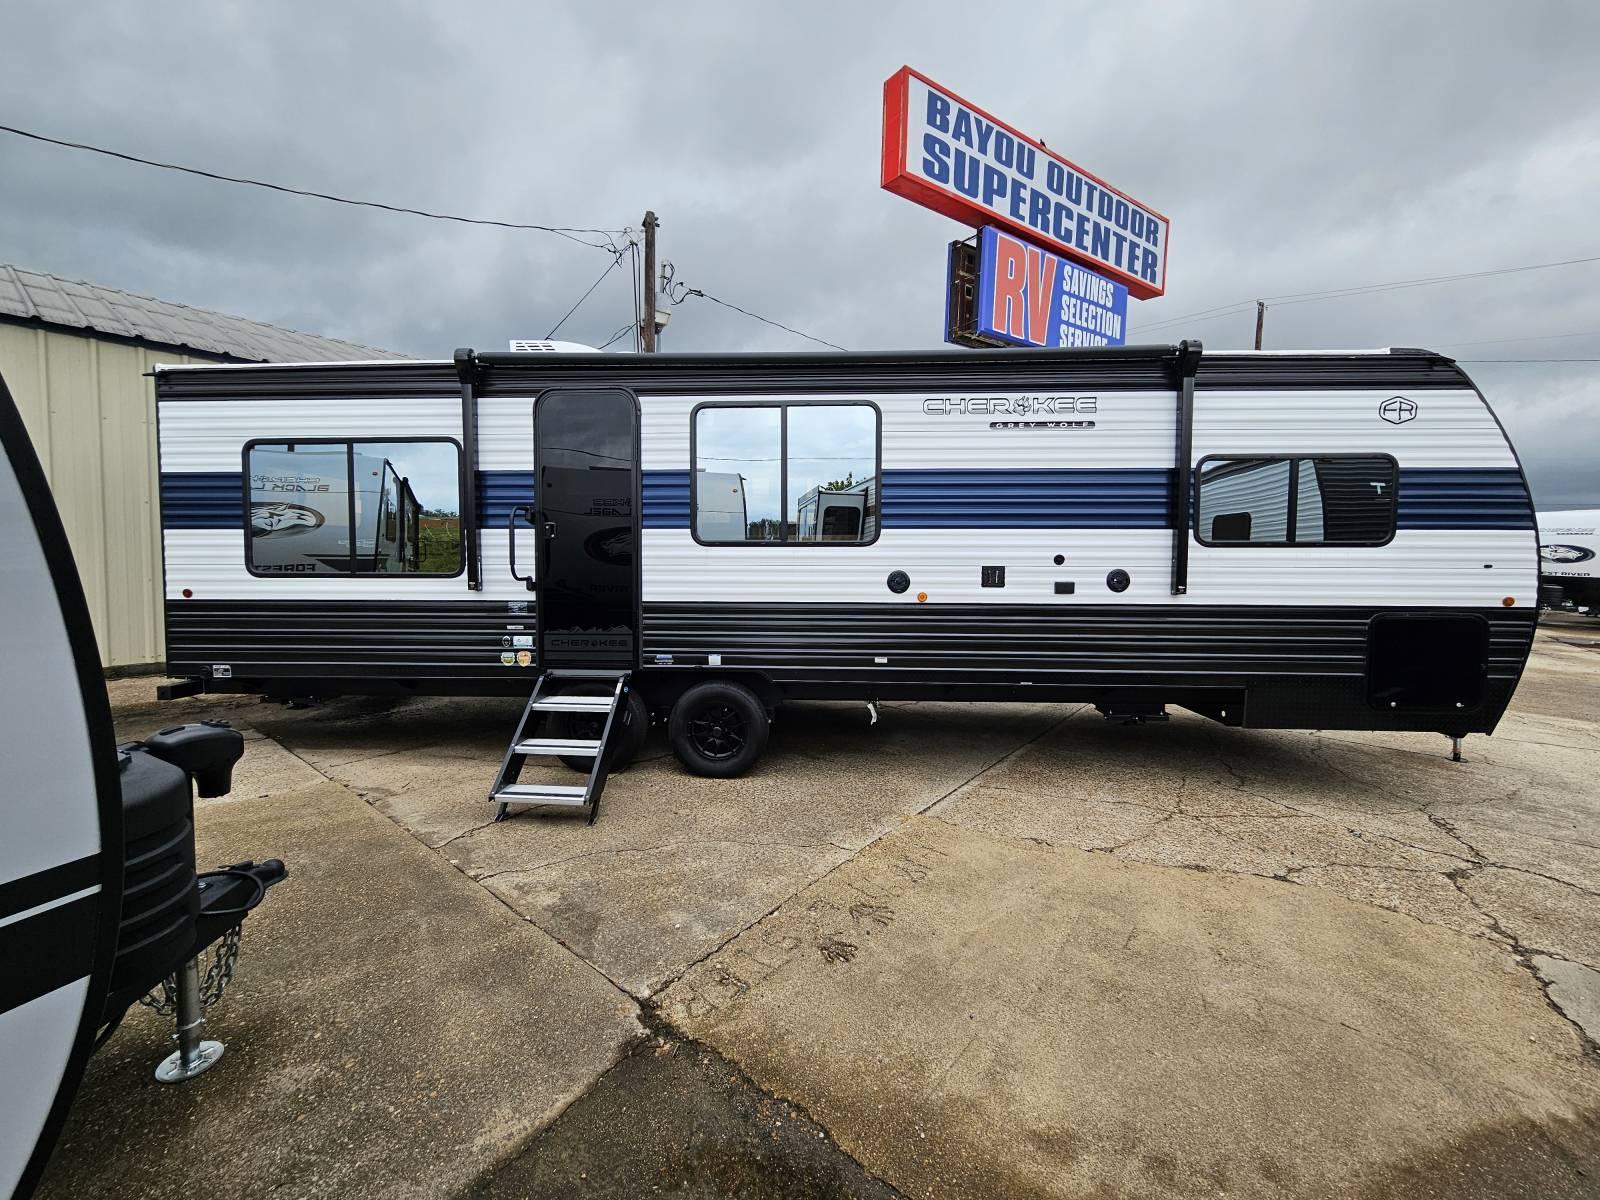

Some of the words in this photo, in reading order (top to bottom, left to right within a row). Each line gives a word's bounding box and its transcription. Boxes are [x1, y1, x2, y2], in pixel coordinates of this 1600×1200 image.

[927, 89, 1035, 180] BAYOU
[1046, 160, 1160, 248] OUTDOOR
[922, 132, 1158, 285] SUPERCENTER
[992, 233, 1057, 346] RV
[1060, 295, 1122, 340] SELECTION
[1062, 265, 1114, 308] SAVINGS
[995, 422, 1036, 430] GREY
[1047, 421, 1089, 429] WOLF
